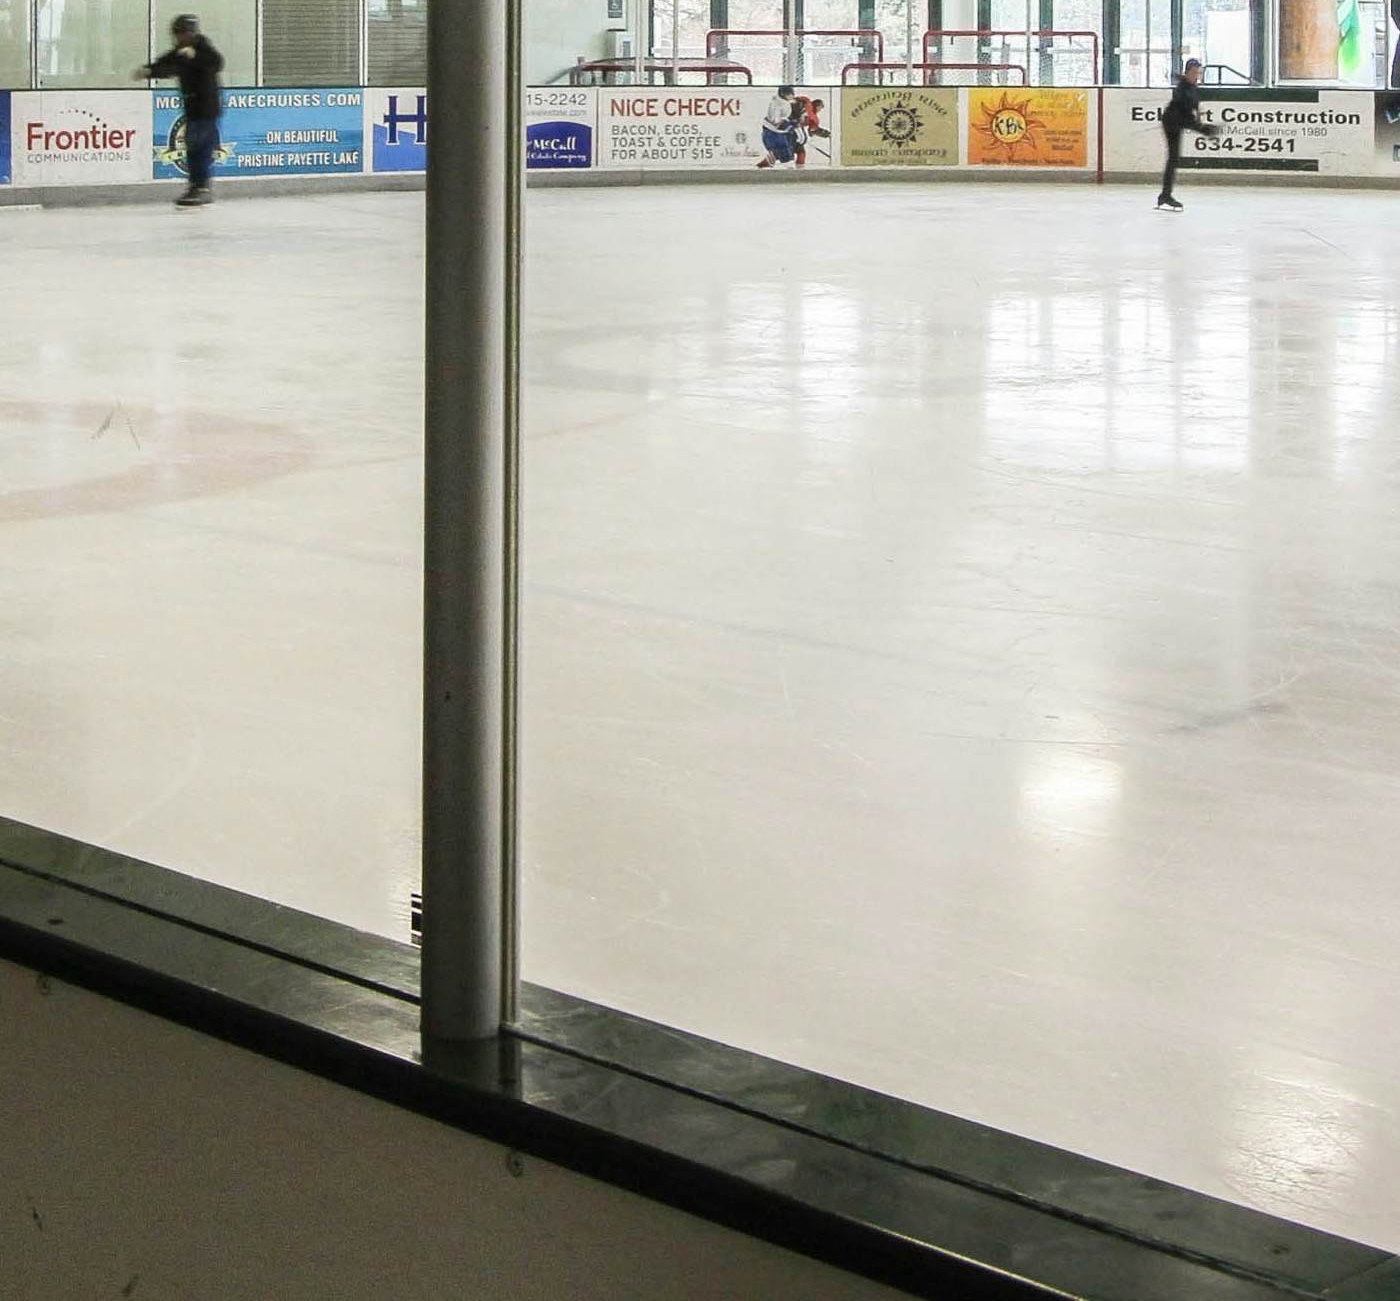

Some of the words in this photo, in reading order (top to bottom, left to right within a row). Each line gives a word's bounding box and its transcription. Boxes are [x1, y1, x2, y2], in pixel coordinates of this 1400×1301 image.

[526, 93, 588, 107] 15-2242
[611, 99, 659, 117] NICE
[664, 99, 740, 117] CHECK!
[1221, 107, 1361, 125] Construction
[27, 123, 136, 150] Frontier
[284, 129, 339, 143] BEAUTIFUL
[612, 124, 660, 136] BACON,
[664, 124, 702, 136] EGGS,
[1227, 126, 1265, 136] McCall
[1268, 127, 1298, 137] since
[1301, 127, 1328, 137] 1980
[612, 136, 653, 148] TOAST
[656, 136, 666, 148] &
[669, 135, 721, 147] COFFEE
[1195, 136, 1296, 153] 634-2541
[27, 152, 131, 164] COMMUNICATIONS
[238, 154, 285, 168] PRISTINE
[287, 151, 331, 166] PAYETTE
[333, 151, 359, 165] LAKE
[612, 149, 637, 160] FOR
[641, 148, 687, 160] ABOUT
[690, 147, 713, 160] $15
